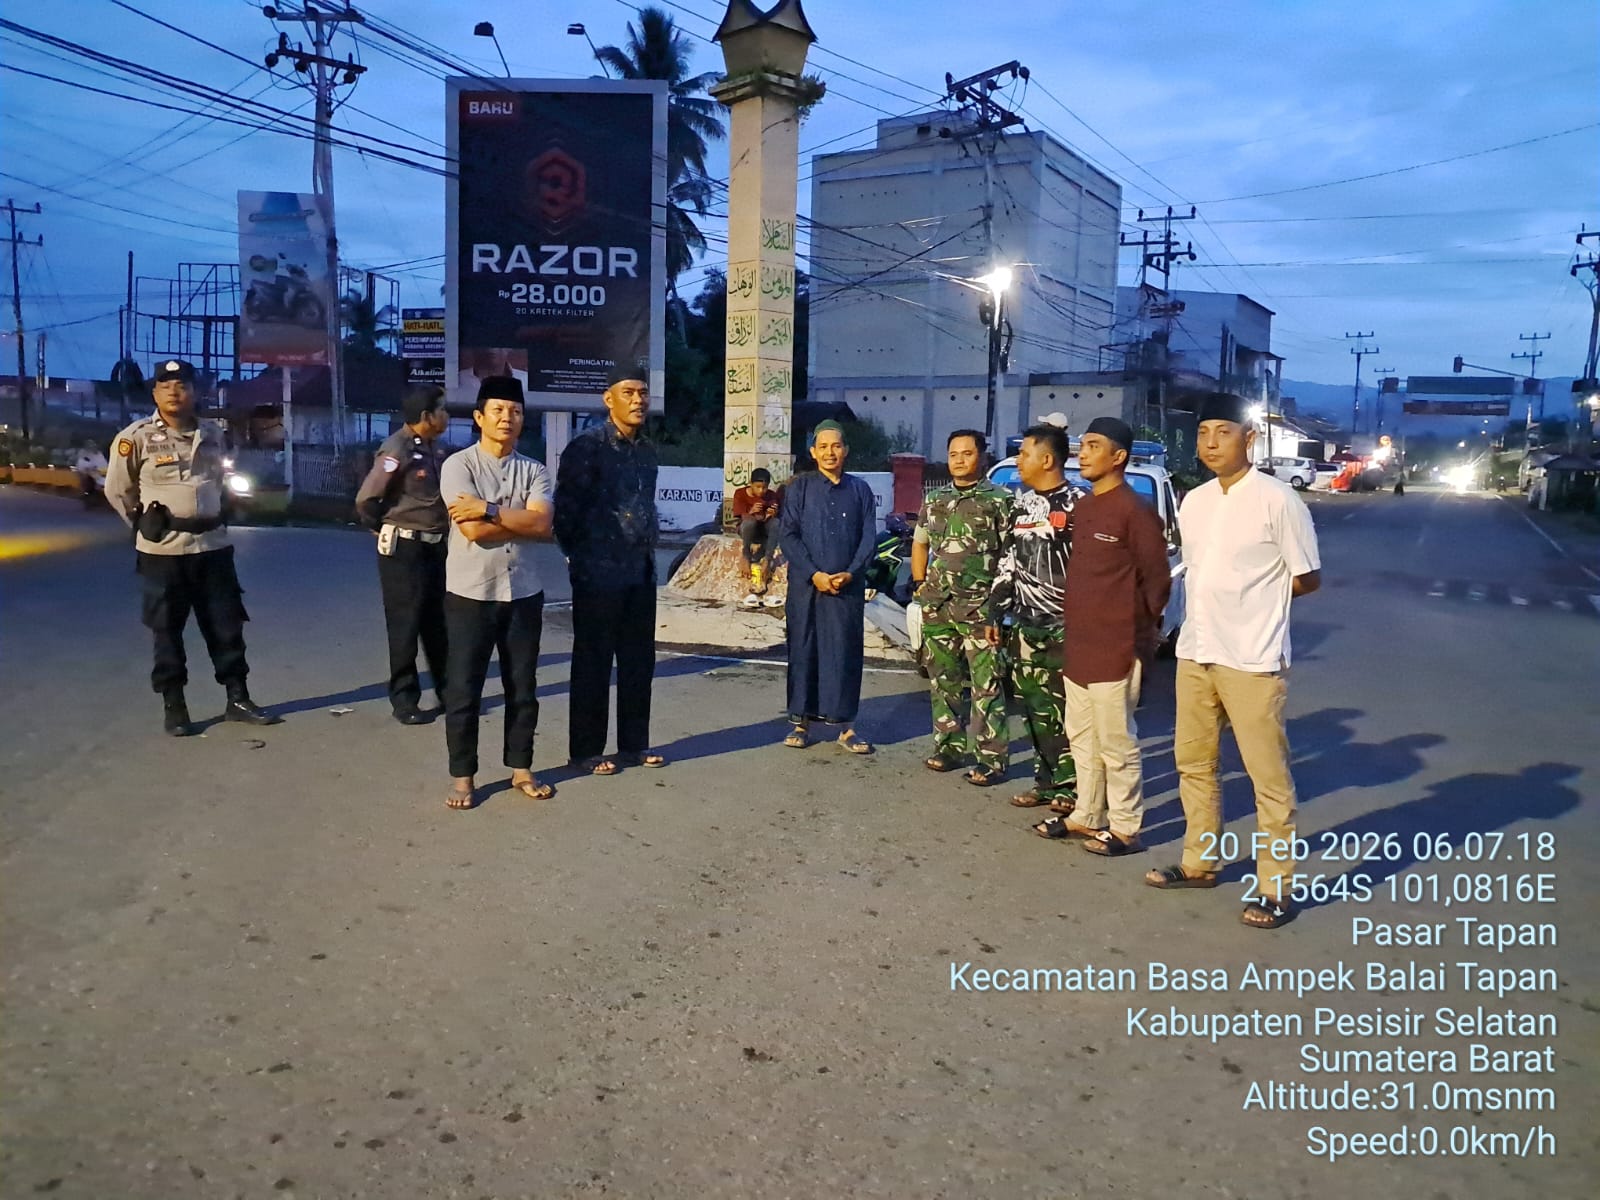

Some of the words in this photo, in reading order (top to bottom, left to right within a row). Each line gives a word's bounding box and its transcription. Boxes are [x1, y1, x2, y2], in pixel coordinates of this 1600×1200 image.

[468, 101, 513, 115] BARU
[472, 243, 639, 278] RAZOR
[498, 290, 510, 299] Rp
[511, 283, 606, 306] 28.000
[566, 308, 594, 317] FILTER
[569, 358, 615, 367] PERINGATAN
[658, 488, 703, 502] KARANG
